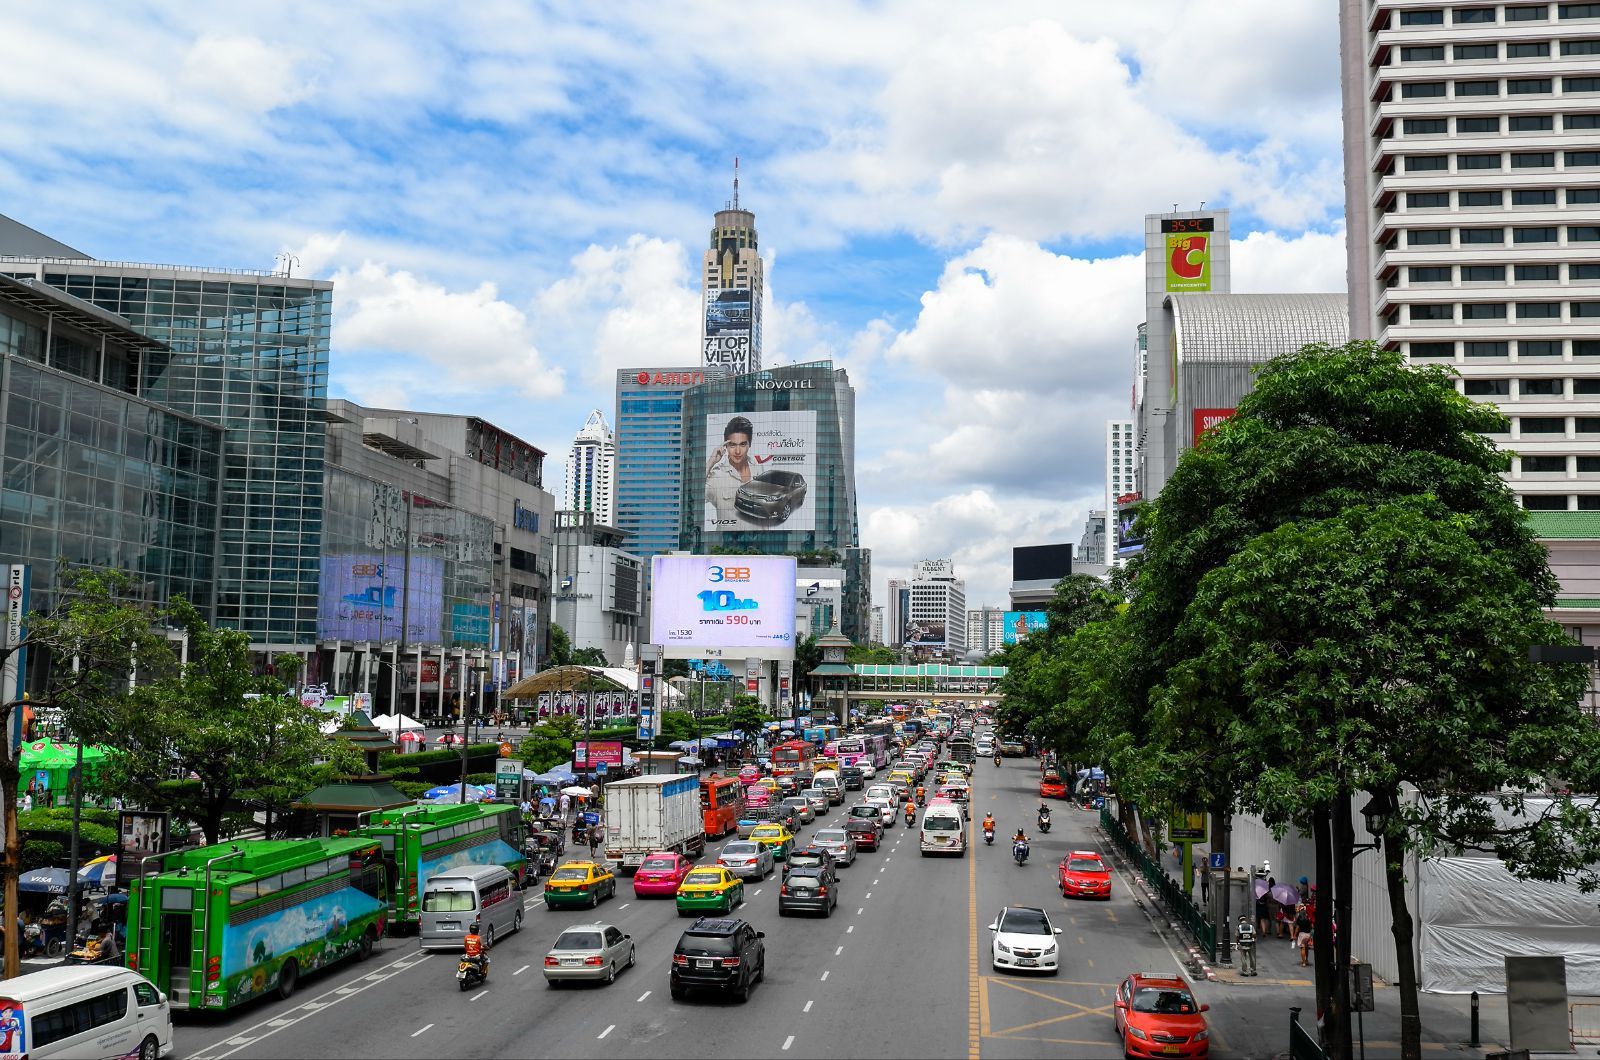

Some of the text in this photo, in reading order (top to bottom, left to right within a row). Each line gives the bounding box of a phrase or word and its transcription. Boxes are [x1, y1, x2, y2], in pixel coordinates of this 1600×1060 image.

[1170, 236, 1208, 279] Big C
[705, 350, 746, 362] VIEW
[756, 379, 816, 390] NOVOTEL
[708, 566, 751, 582] 3BB
[726, 616, 748, 625] 590
[48, 884, 64, 892] VISA
